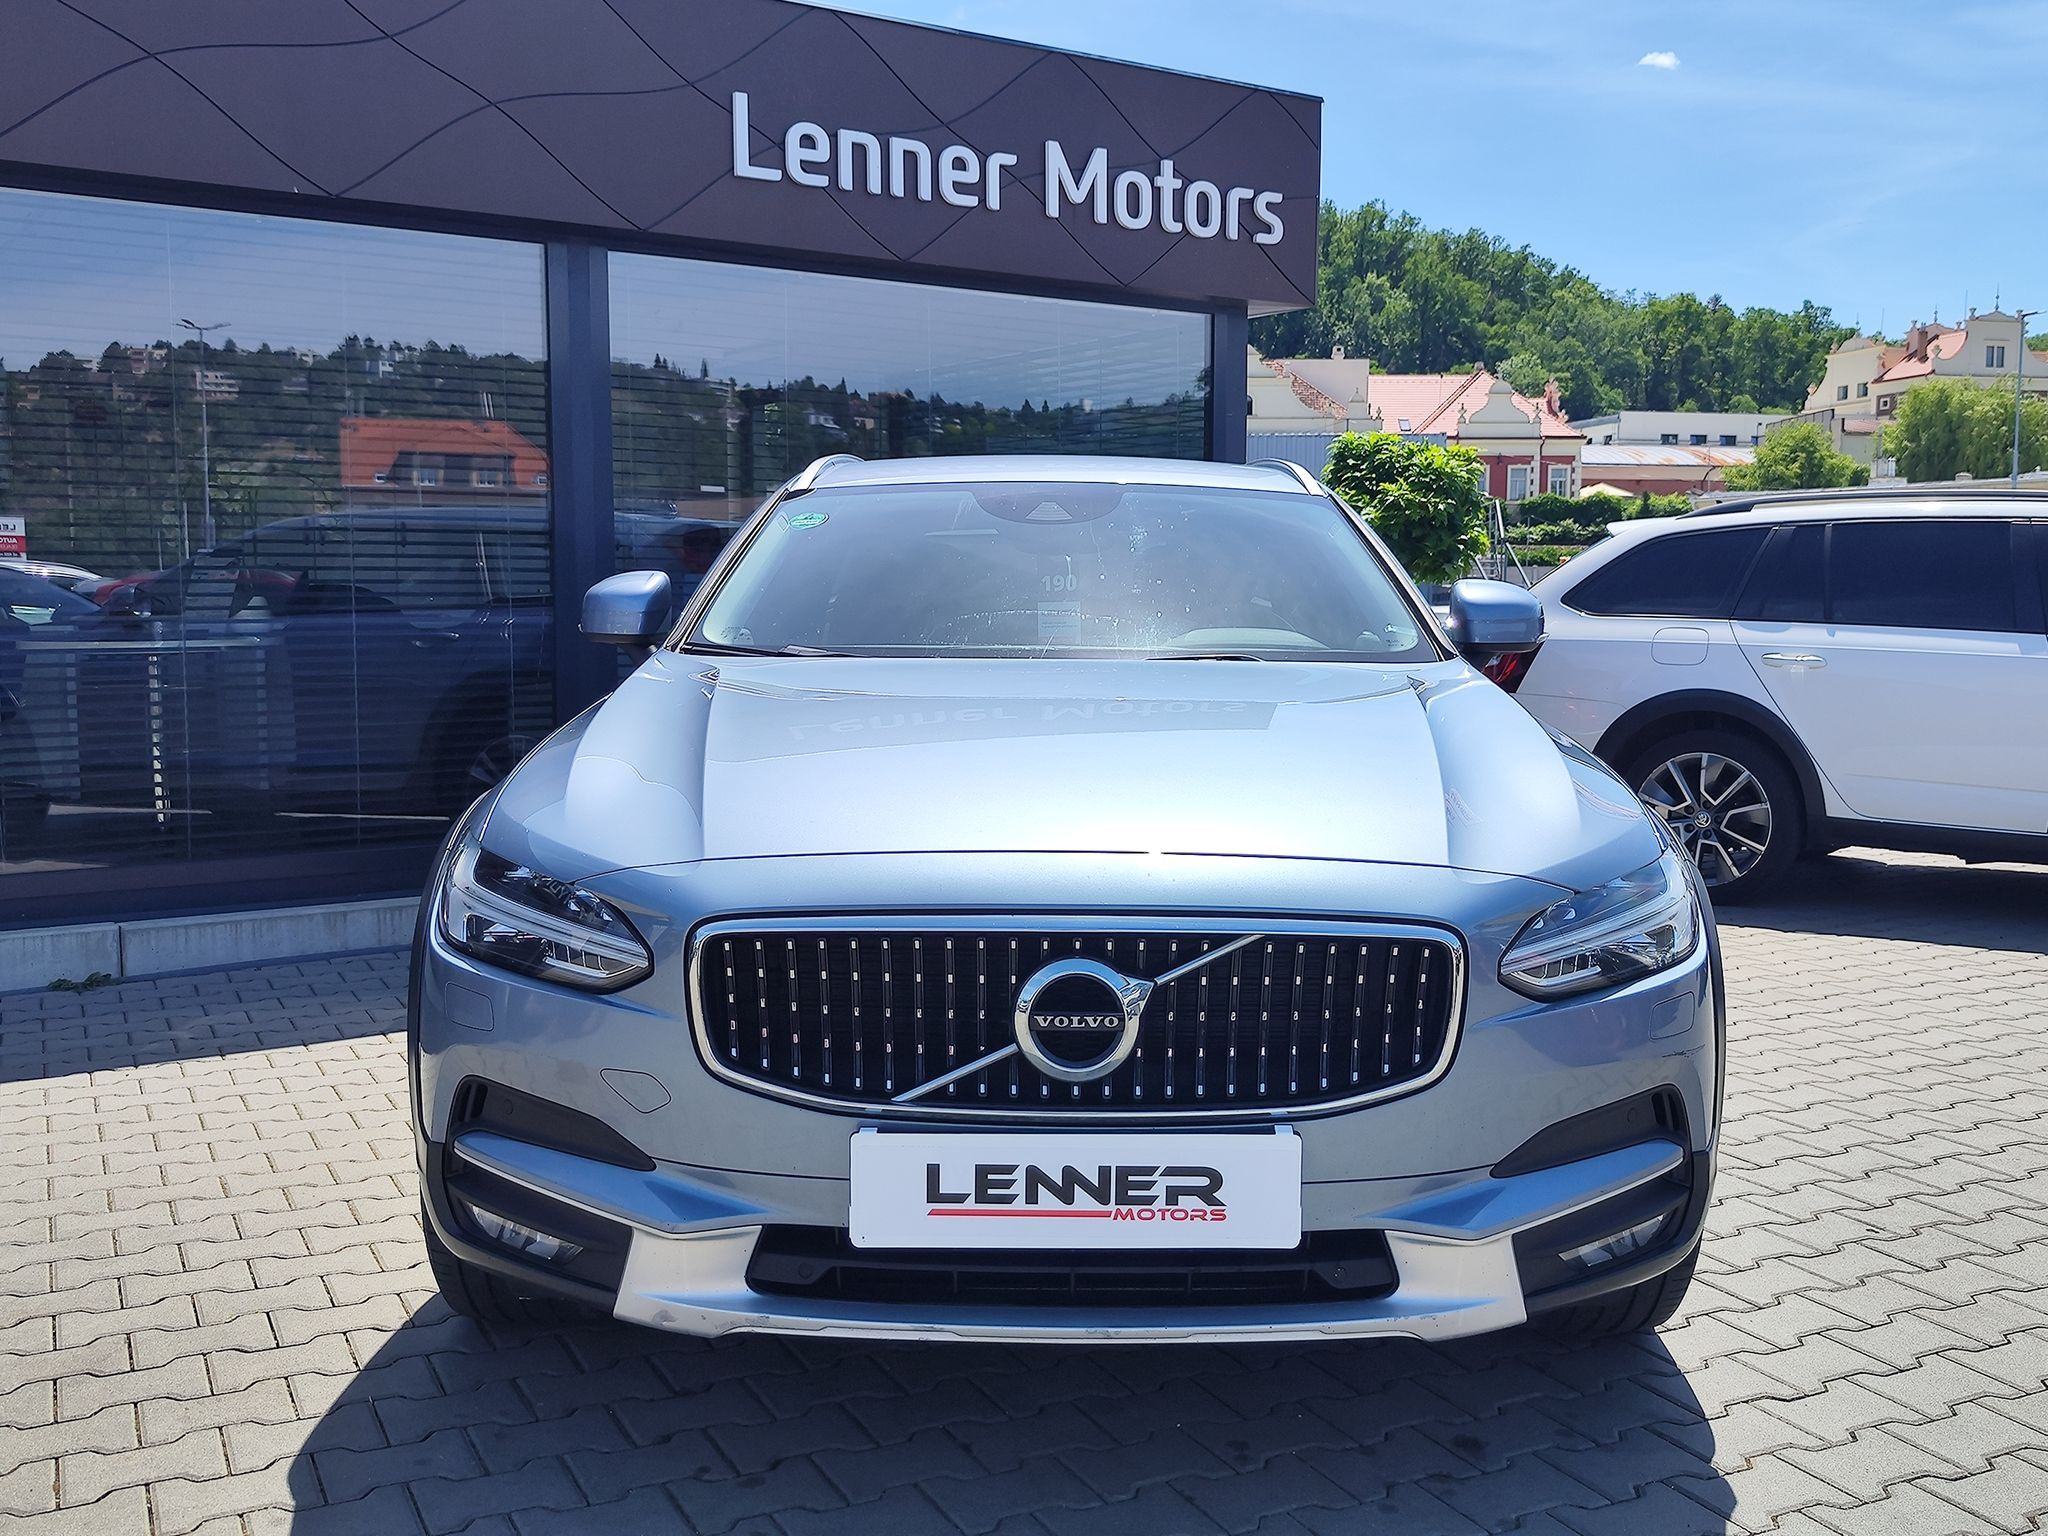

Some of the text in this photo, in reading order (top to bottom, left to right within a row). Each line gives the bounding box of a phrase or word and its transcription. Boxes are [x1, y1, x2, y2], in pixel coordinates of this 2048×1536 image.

[732, 90, 1285, 245] Lenner Motors
[1040, 574, 1078, 592] 190
[1033, 1015, 1119, 1028] VOLVO
[926, 1163, 1228, 1207] LENNER
[1112, 1207, 1228, 1222] MOTORS
